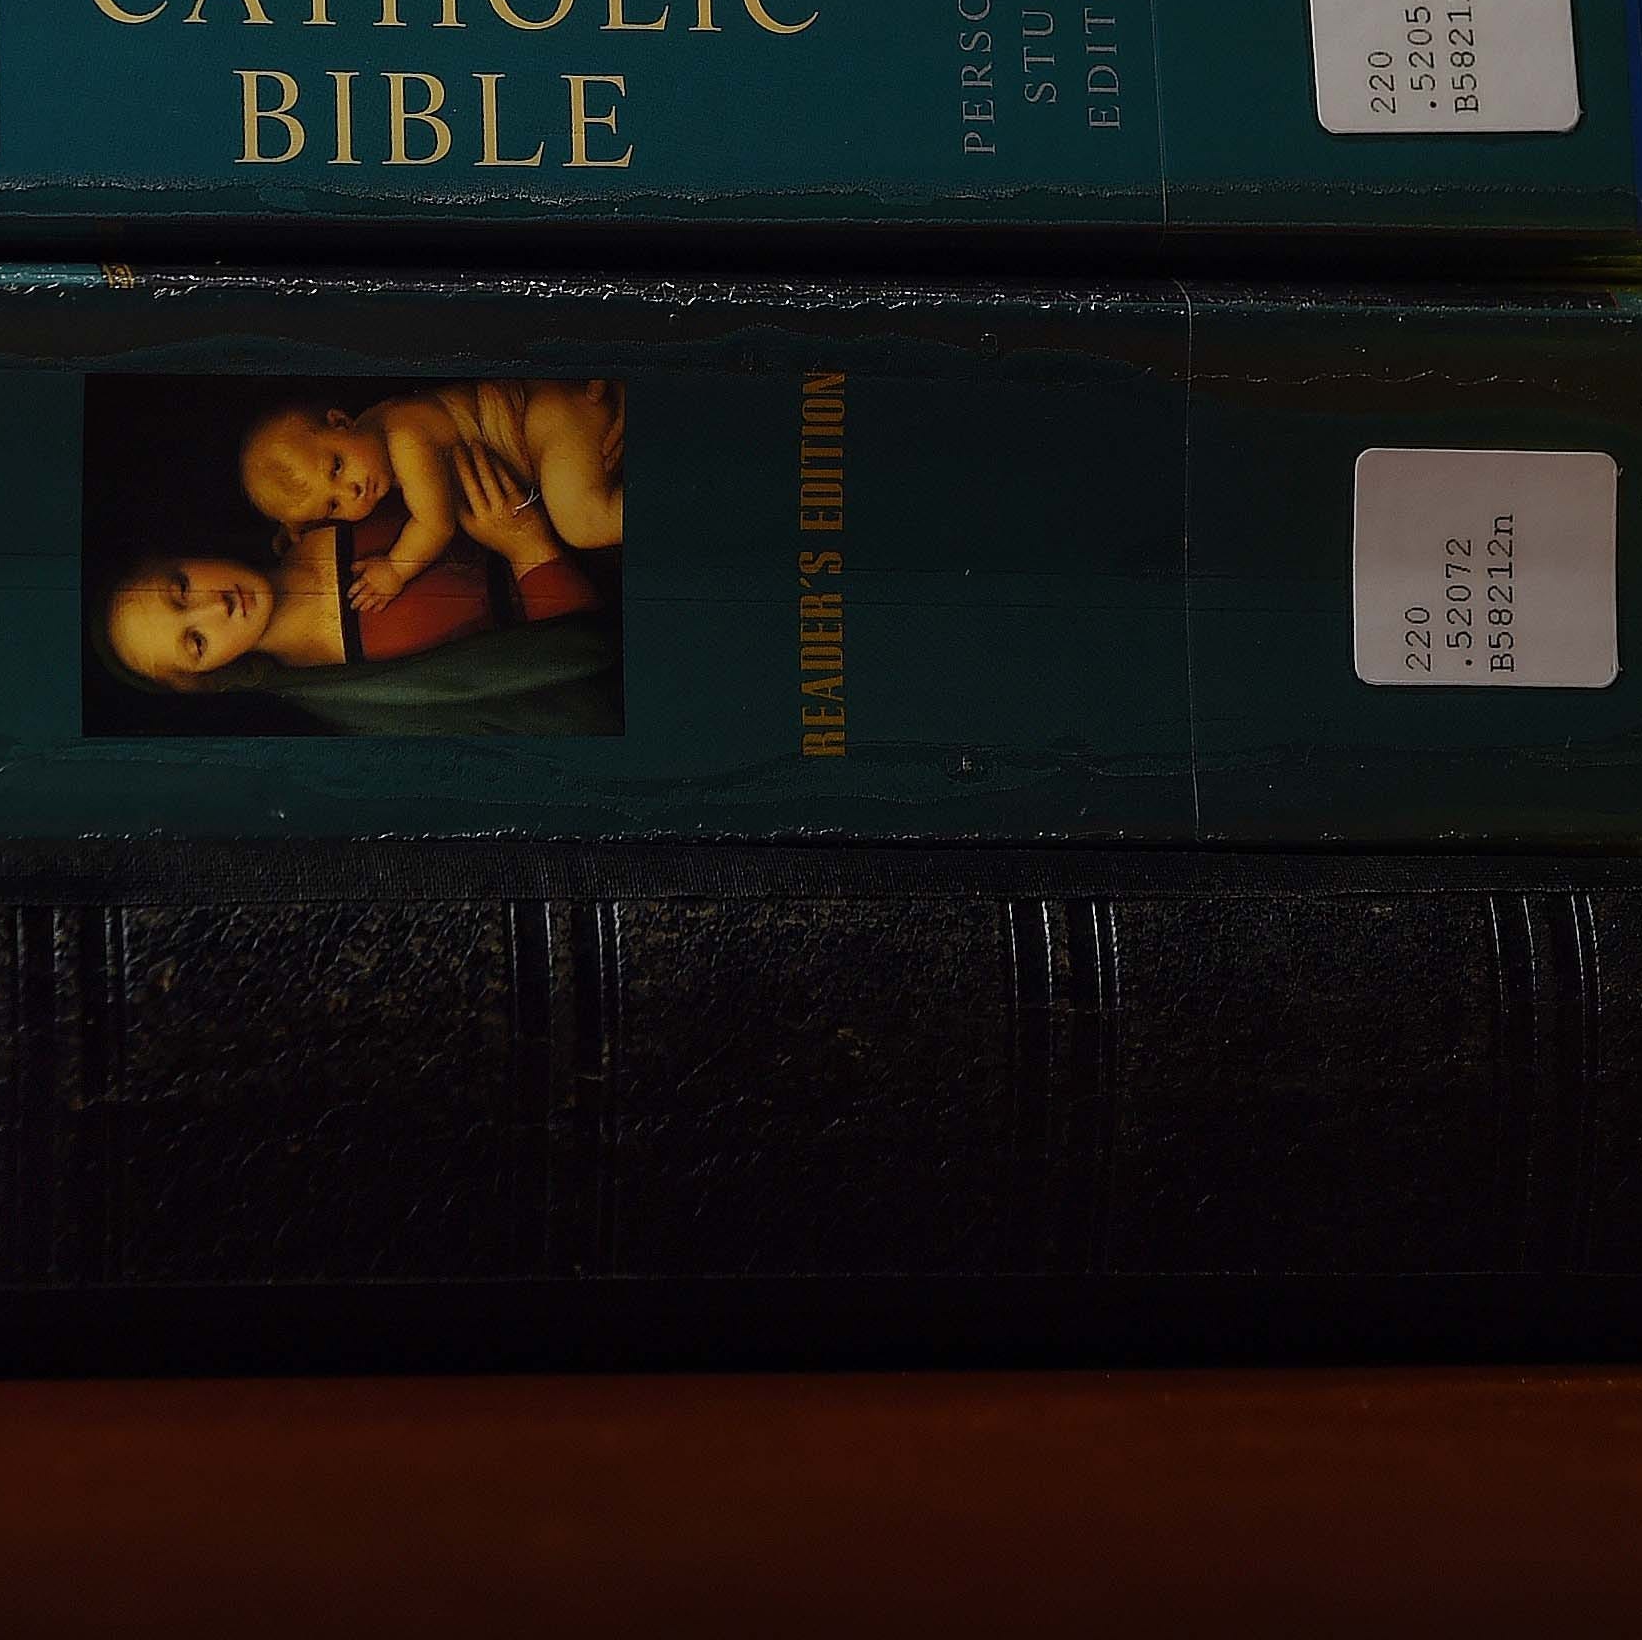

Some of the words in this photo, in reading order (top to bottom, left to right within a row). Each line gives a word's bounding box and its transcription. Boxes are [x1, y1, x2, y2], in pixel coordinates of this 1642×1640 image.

[233, 69, 634, 169] BIBLE
[1369, 50, 1397, 114] 220
[799, 369, 847, 531] EDITION
[798, 550, 847, 758] READER'S
[1405, 605, 1432, 672] 220
[1447, 537, 1473, 667] .52072
[1489, 513, 1514, 673] B58212n
